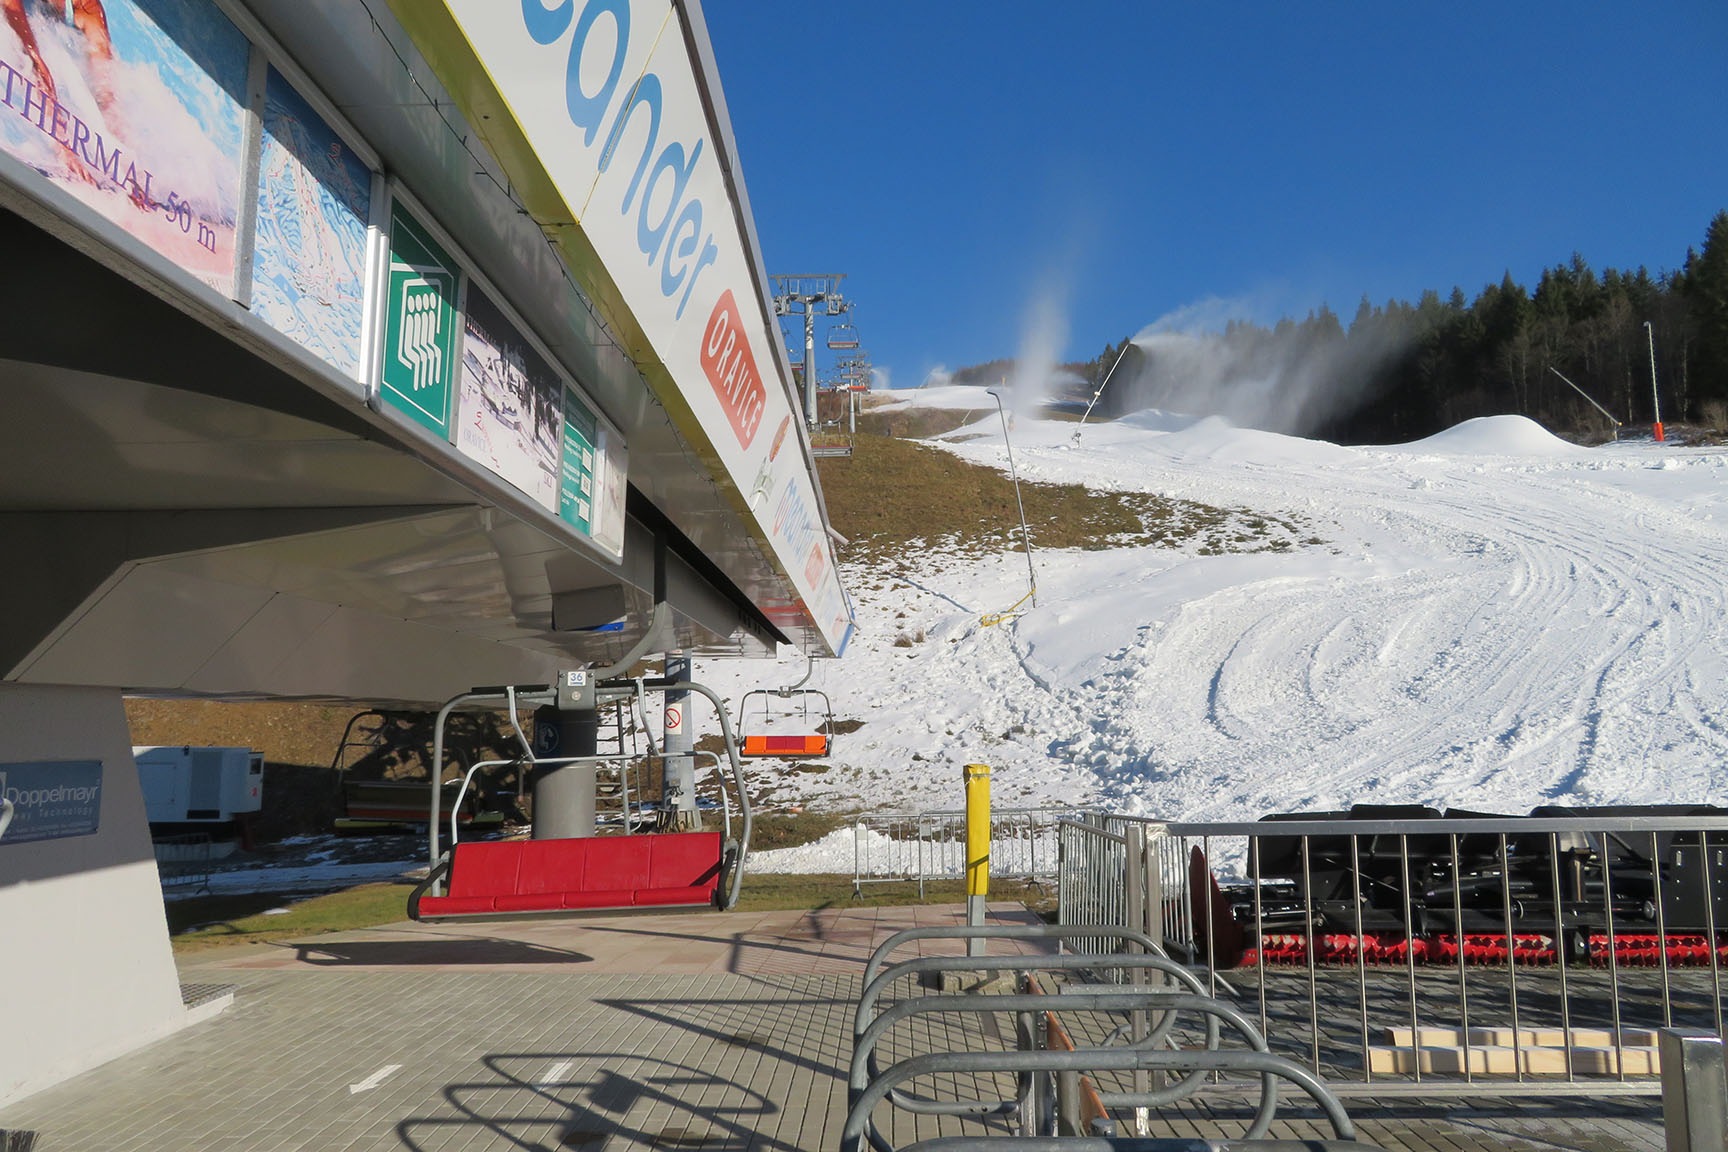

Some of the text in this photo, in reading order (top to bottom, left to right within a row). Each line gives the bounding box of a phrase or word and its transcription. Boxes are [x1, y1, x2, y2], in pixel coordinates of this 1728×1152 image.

[0, 60, 217, 254] THERMAL 50 m
[708, 310, 762, 439] ORAVICE
[570, 672, 583, 682] 36
[6, 784, 98, 807] Doppelmayr
